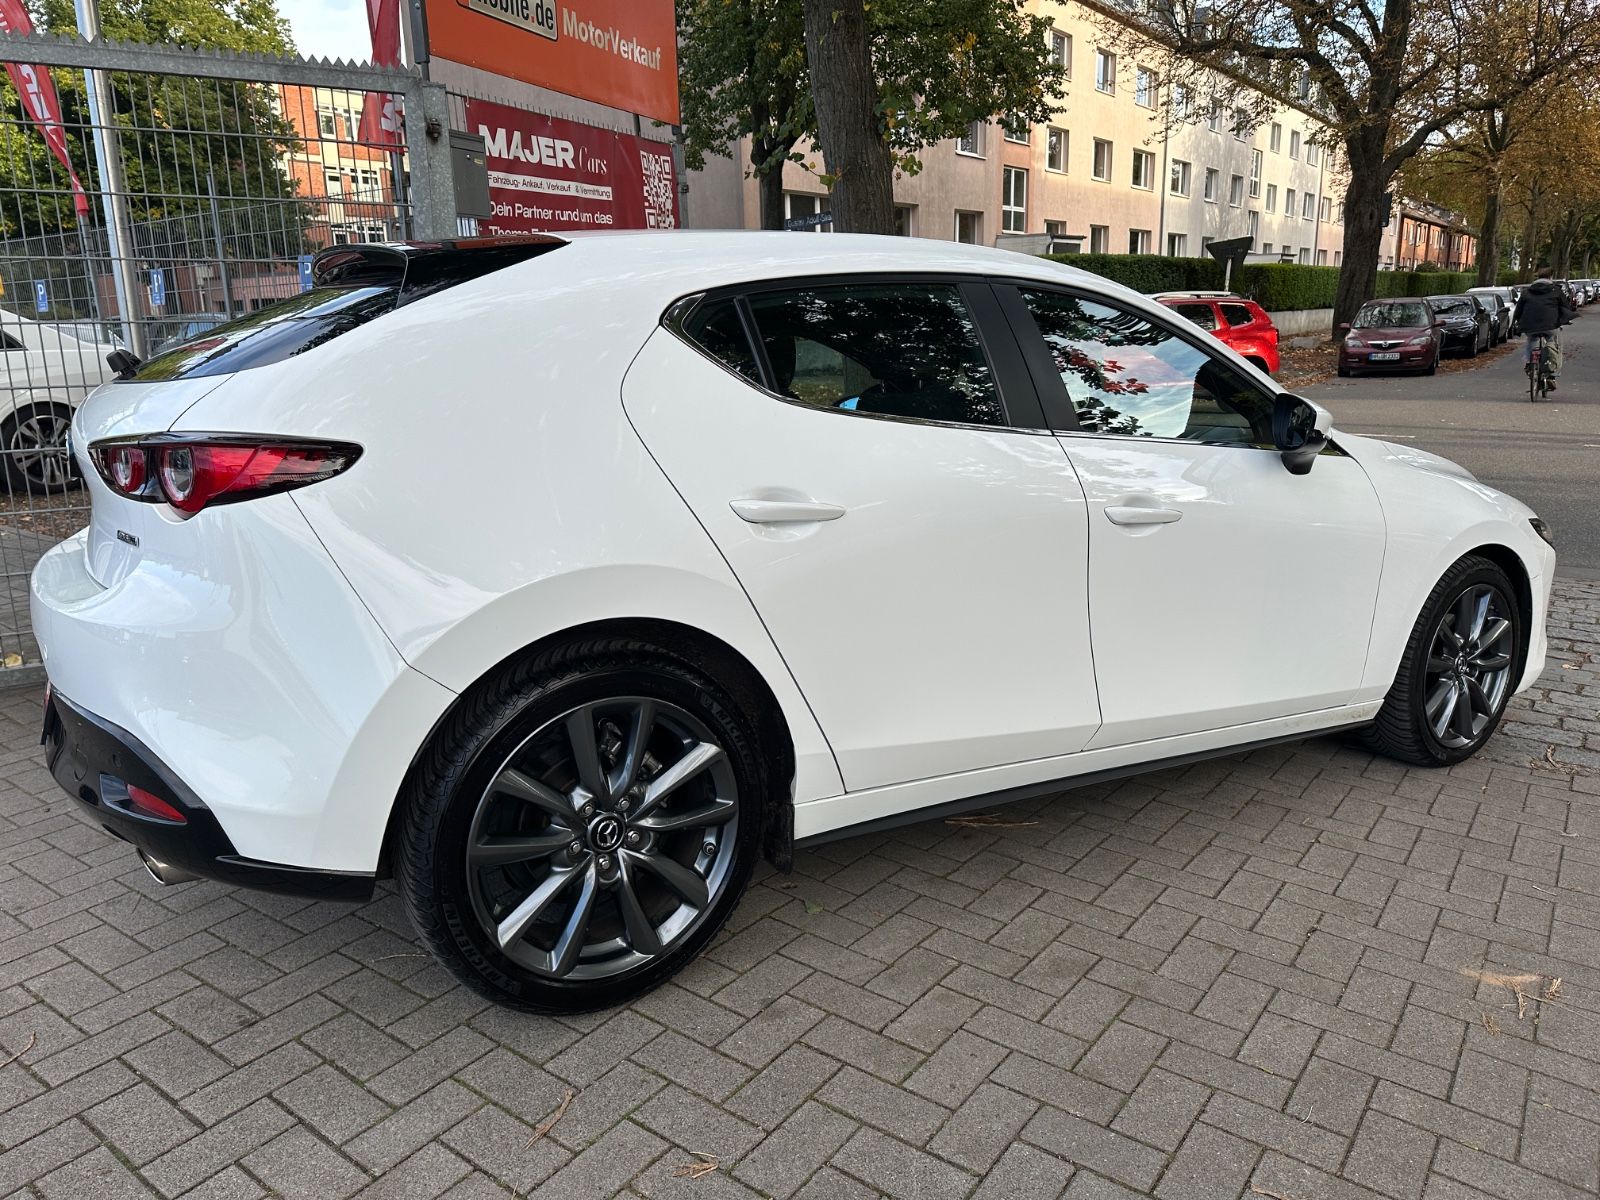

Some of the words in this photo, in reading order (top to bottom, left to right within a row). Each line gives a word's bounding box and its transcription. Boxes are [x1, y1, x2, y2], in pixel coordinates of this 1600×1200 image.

[478, 0, 554, 30] ile.de
[563, 8, 661, 70] MotorVerkauf
[478, 124, 576, 169] MAJER
[579, 146, 607, 175] Cars
[546, 182, 571, 193] Verkauf
[490, 201, 512, 217] Dein
[515, 203, 553, 220] Partner
[555, 209, 579, 221] rund
[580, 213, 593, 223] um
[594, 212, 613, 225] das
[37, 283, 44, 301] P
